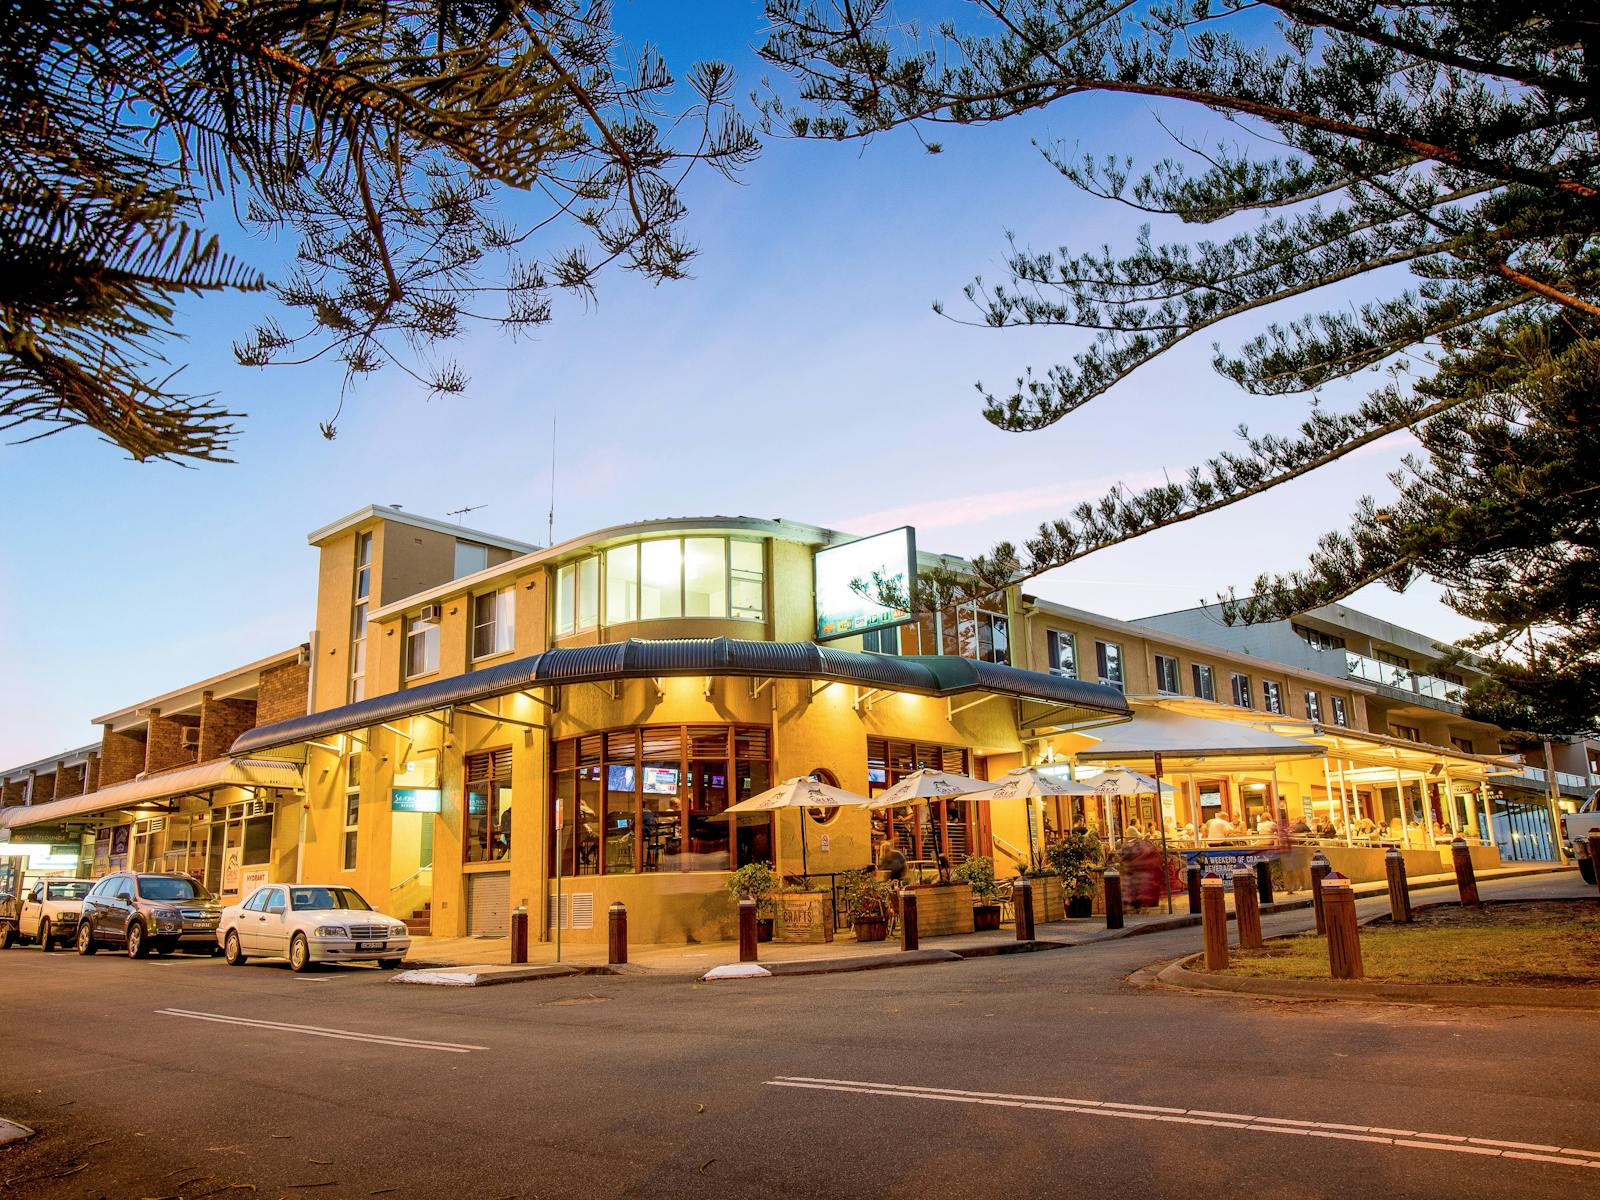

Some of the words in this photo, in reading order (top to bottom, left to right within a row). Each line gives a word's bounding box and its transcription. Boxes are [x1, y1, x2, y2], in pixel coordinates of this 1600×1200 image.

[1204, 856, 1209, 864] A
[1209, 856, 1237, 864] WEEKEND
[783, 911, 813, 923] CRAFTS
